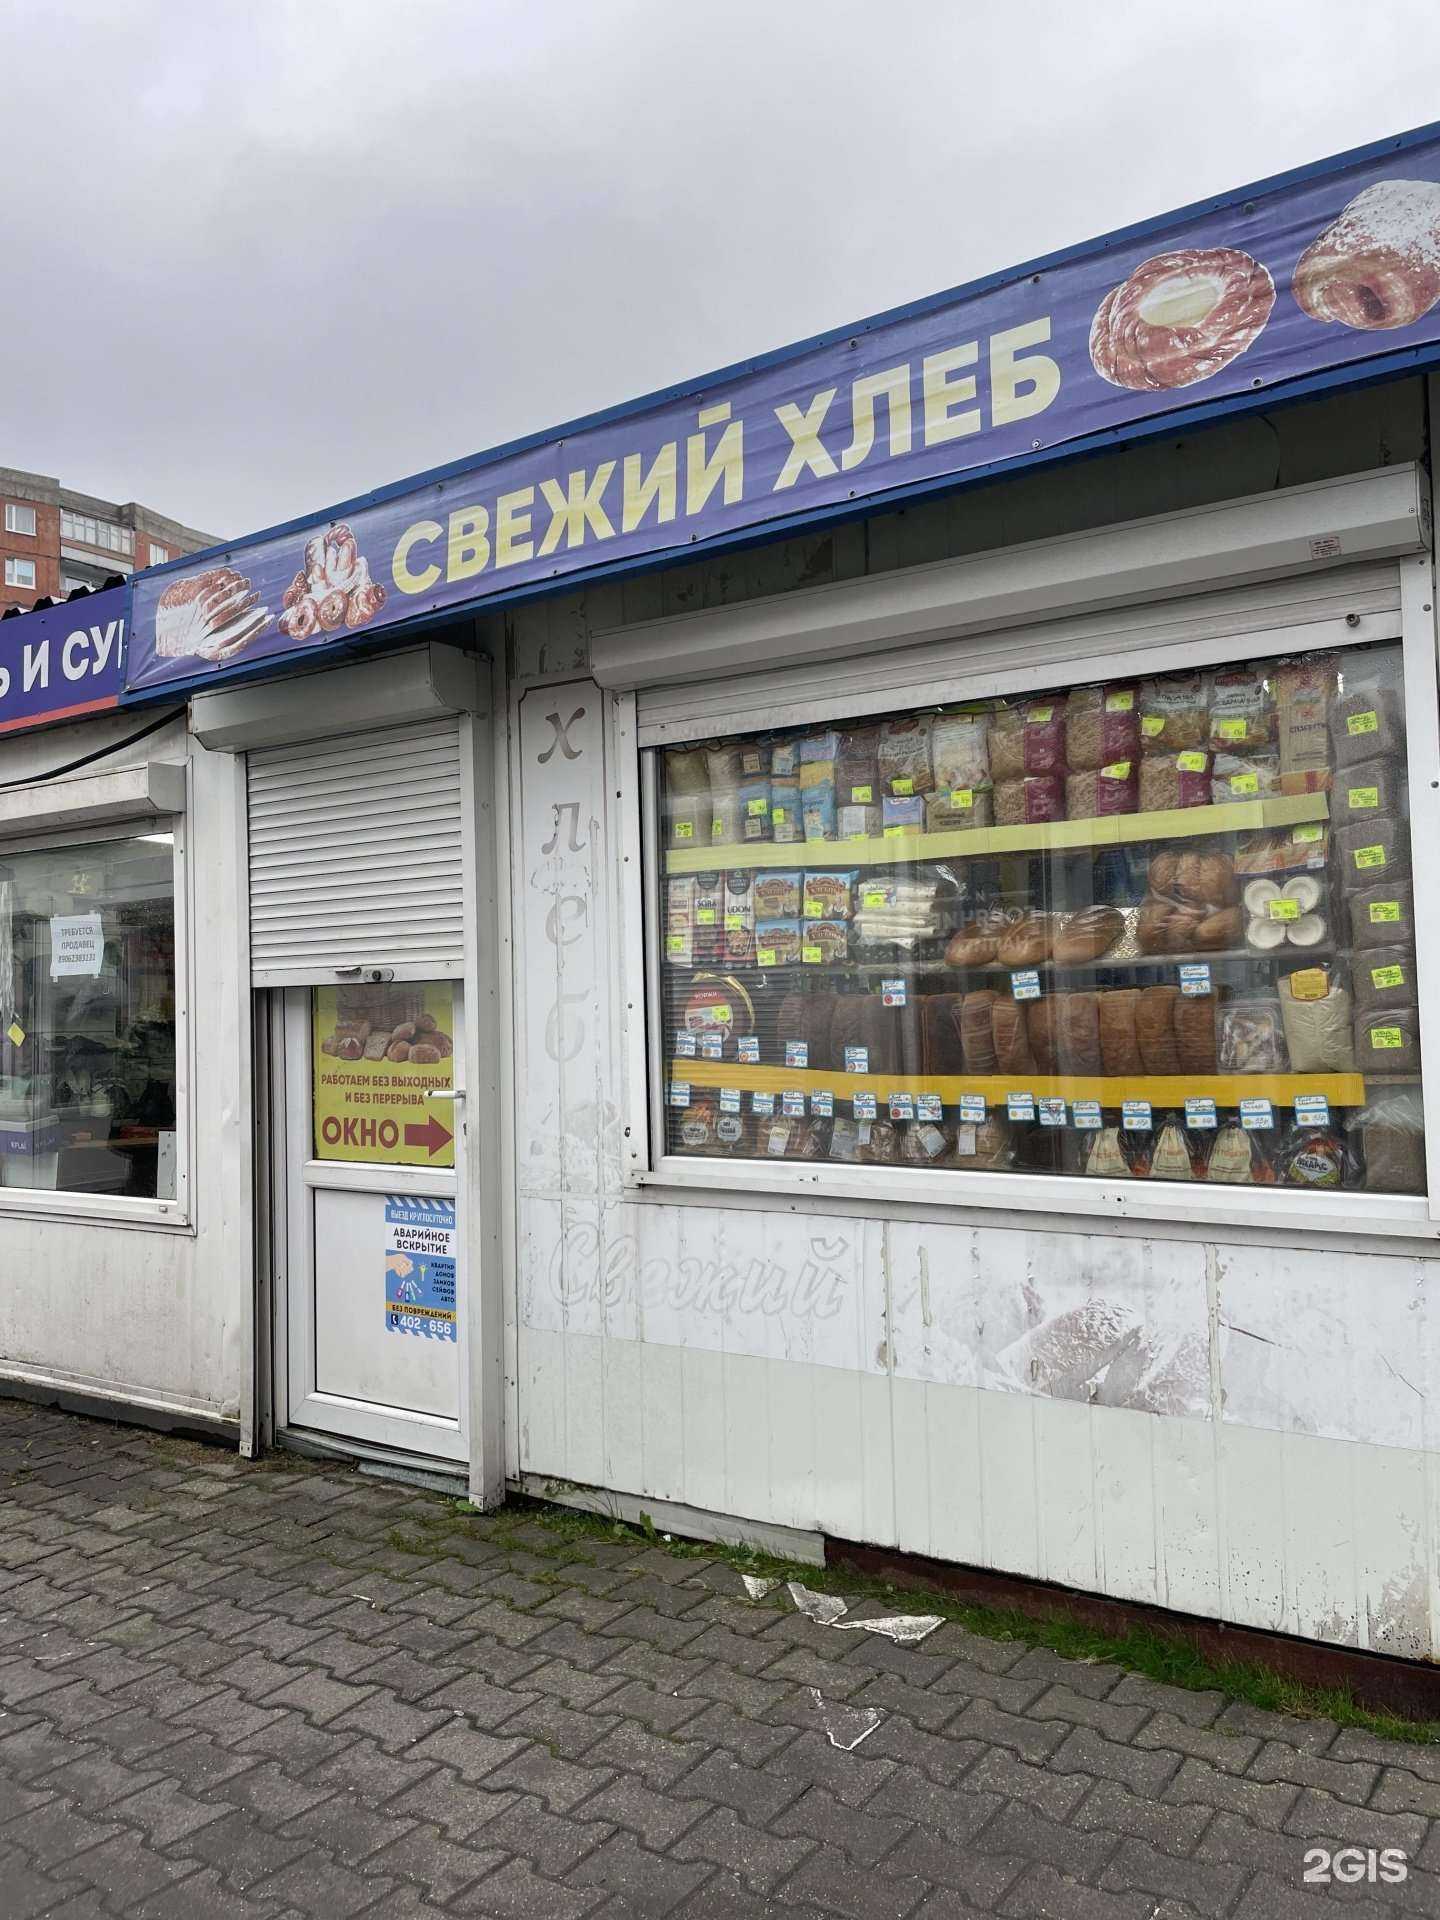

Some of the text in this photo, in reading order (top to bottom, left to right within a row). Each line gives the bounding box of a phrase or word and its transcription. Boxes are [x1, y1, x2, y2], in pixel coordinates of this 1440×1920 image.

[392, 316, 1061, 595] СВЕЖИЙ ХЛЕБ
[23, 639, 50, 693] И
[62, 619, 125, 681] СУ
[727, 904, 751, 914] UDON
[61, 926, 95, 937] ТРЕБУЕТСЯ
[61, 939, 95, 951] ПРОДАВЕЦ
[321, 1074, 452, 1090] РАБОТАЕМ БЕЗ ВЫХОДНЫХ
[345, 1091, 425, 1106] И БЕЗ ПЕРЕРЫВА
[322, 1115, 400, 1149] ОКНО
[393, 1226, 451, 1243] АВАРИЙНОЕ
[396, 1238, 448, 1255] ВСКРЫТИЕ
[392, 1304, 452, 1320] БЕЗ ПОВРЕЖДЕНИЙ
[400, 1315, 421, 1330] 402
[429, 1319, 452, 1335] 656
